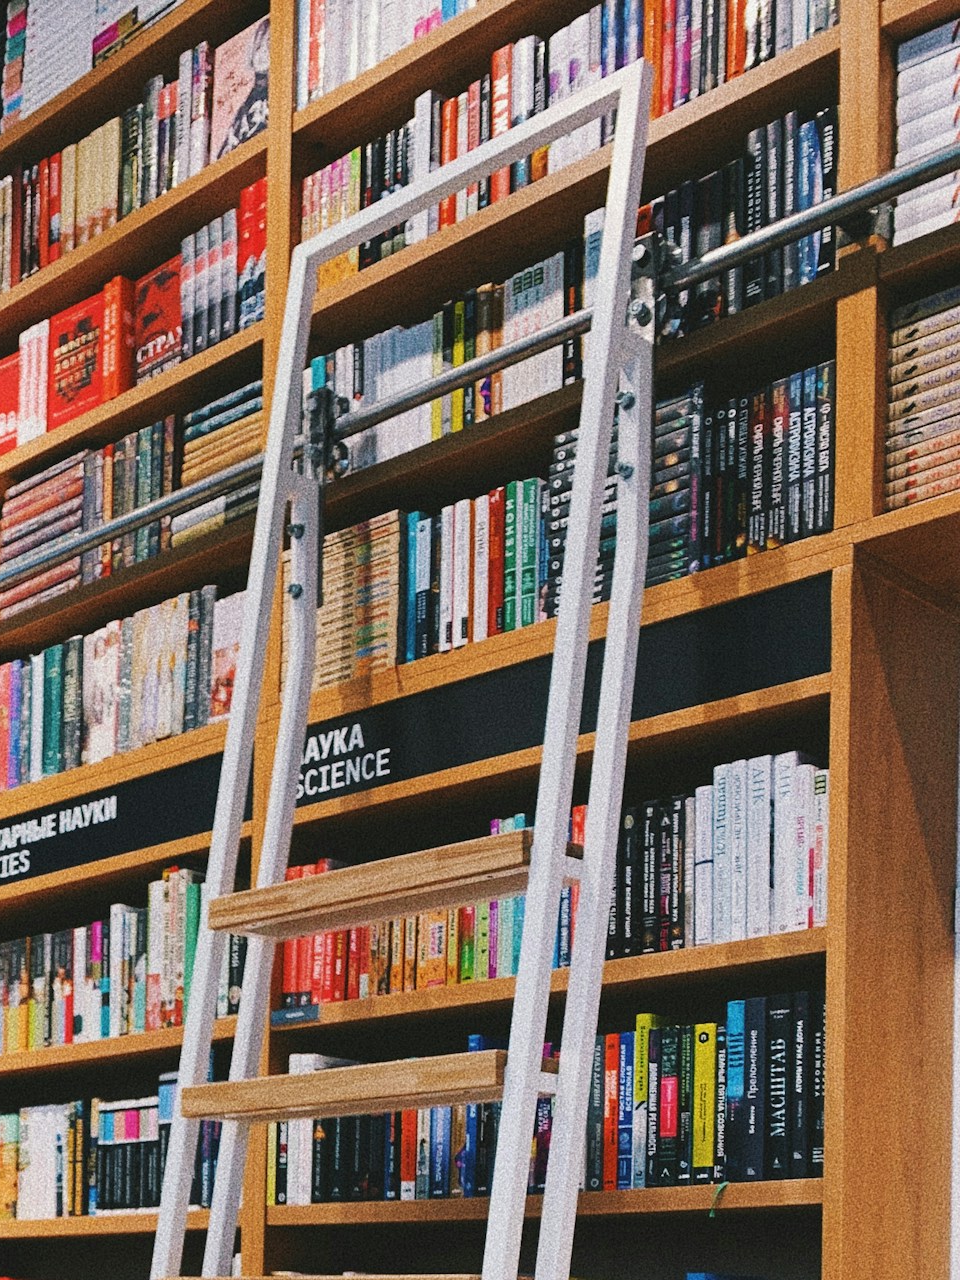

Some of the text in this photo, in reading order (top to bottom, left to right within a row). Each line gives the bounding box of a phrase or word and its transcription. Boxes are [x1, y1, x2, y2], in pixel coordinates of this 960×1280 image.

[788, 411, 801, 482] АСТРОФИЗИКА
[802, 407, 816, 478] АСТРОФИЗИКА
[818, 451, 830, 471] БОГА
[504, 498, 515, 558] ГЕНОМ
[300, 724, 365, 765] АУКА
[296, 748, 391, 799] SCIENCE
[58, 796, 118, 834] НАУКИ
[715, 776, 727, 829] Human
[796, 1020, 805, 1044] ДОМА
[618, 1044, 626, 1084] СЛОЖНАЯ
[718, 1049, 726, 1083] ТЕМНЫЕ
[747, 1030, 759, 1099] Преломление
[796, 1066, 804, 1093] АТОМЫ
[625, 1066, 633, 1111] ВСЕЛЕННАЯ
[647, 1063, 657, 1156] ДОПОЛНЕННАЯ РЕАЛЬНОСТЬ
[770, 1038, 786, 1136] МАСШТАБ
[717, 1113, 725, 1156] СОЗНАНИЯ
